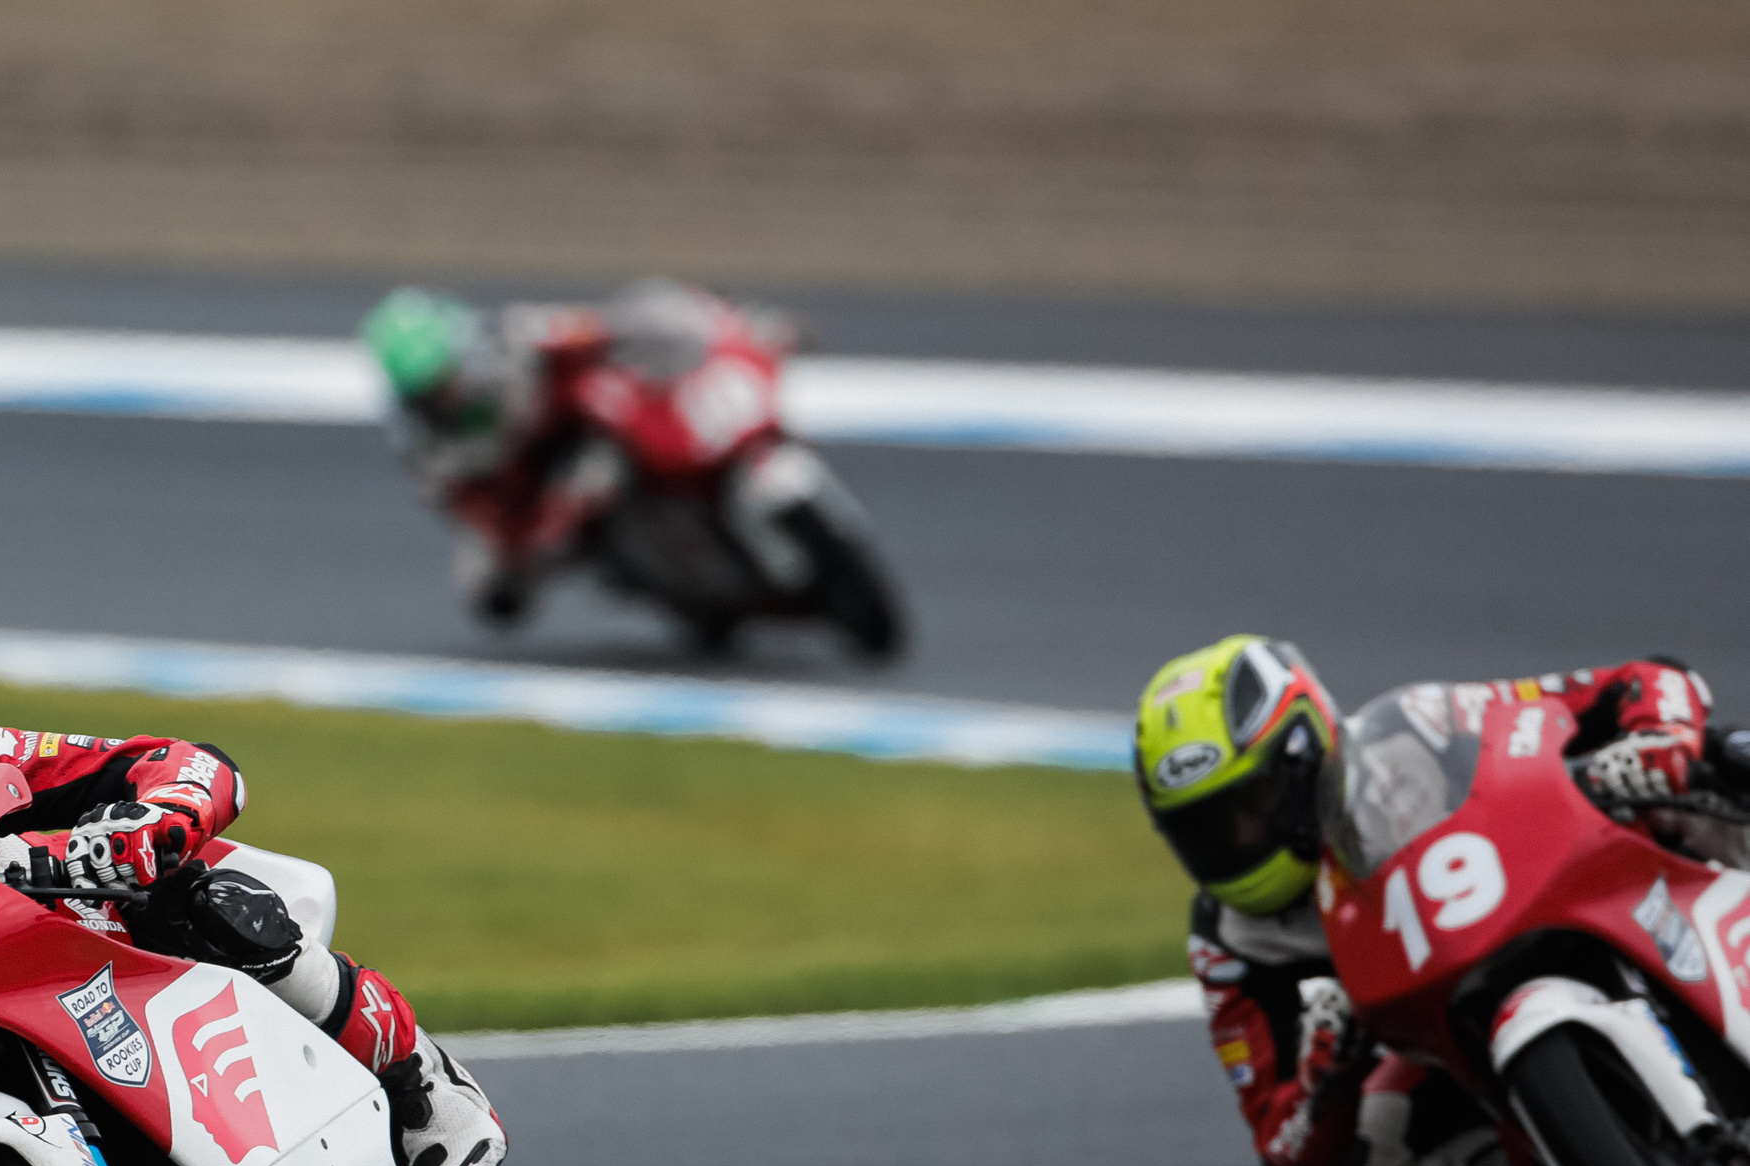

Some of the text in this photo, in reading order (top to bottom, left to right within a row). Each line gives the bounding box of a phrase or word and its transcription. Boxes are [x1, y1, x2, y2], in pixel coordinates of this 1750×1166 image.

[1382, 831, 1507, 973] 19
[71, 982, 108, 1014] ROAD TO
[106, 1037, 143, 1070] ROOKIES
[125, 1057, 142, 1076] CUP
